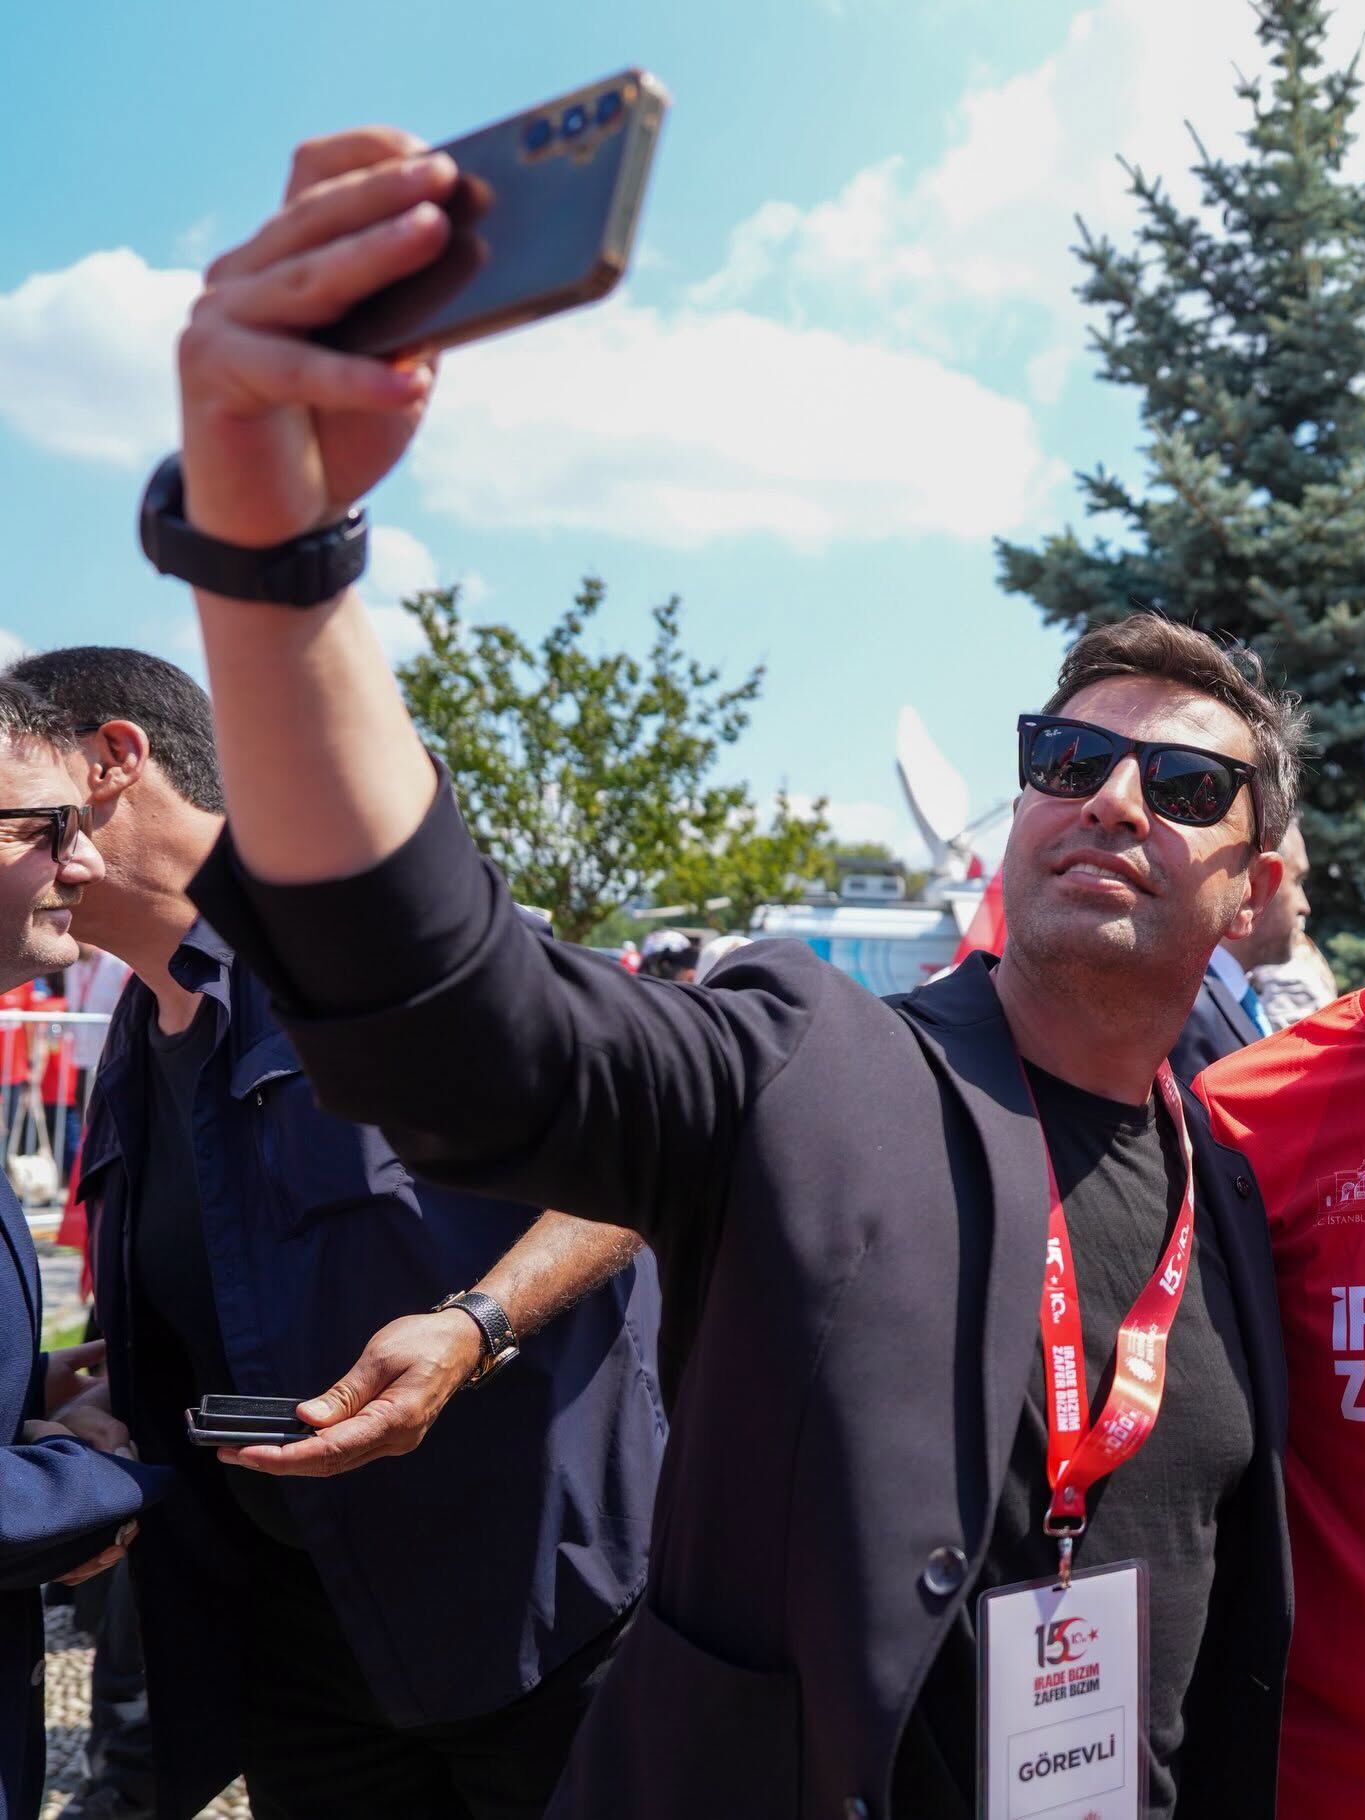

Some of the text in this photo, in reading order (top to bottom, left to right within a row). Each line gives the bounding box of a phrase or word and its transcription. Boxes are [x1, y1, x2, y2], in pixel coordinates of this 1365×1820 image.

[1068, 1663, 1100, 1682] BİZİM
[1034, 1678, 1100, 1706] ZAFER BİZİM
[1018, 1733, 1116, 1782] GÖREVLİ
